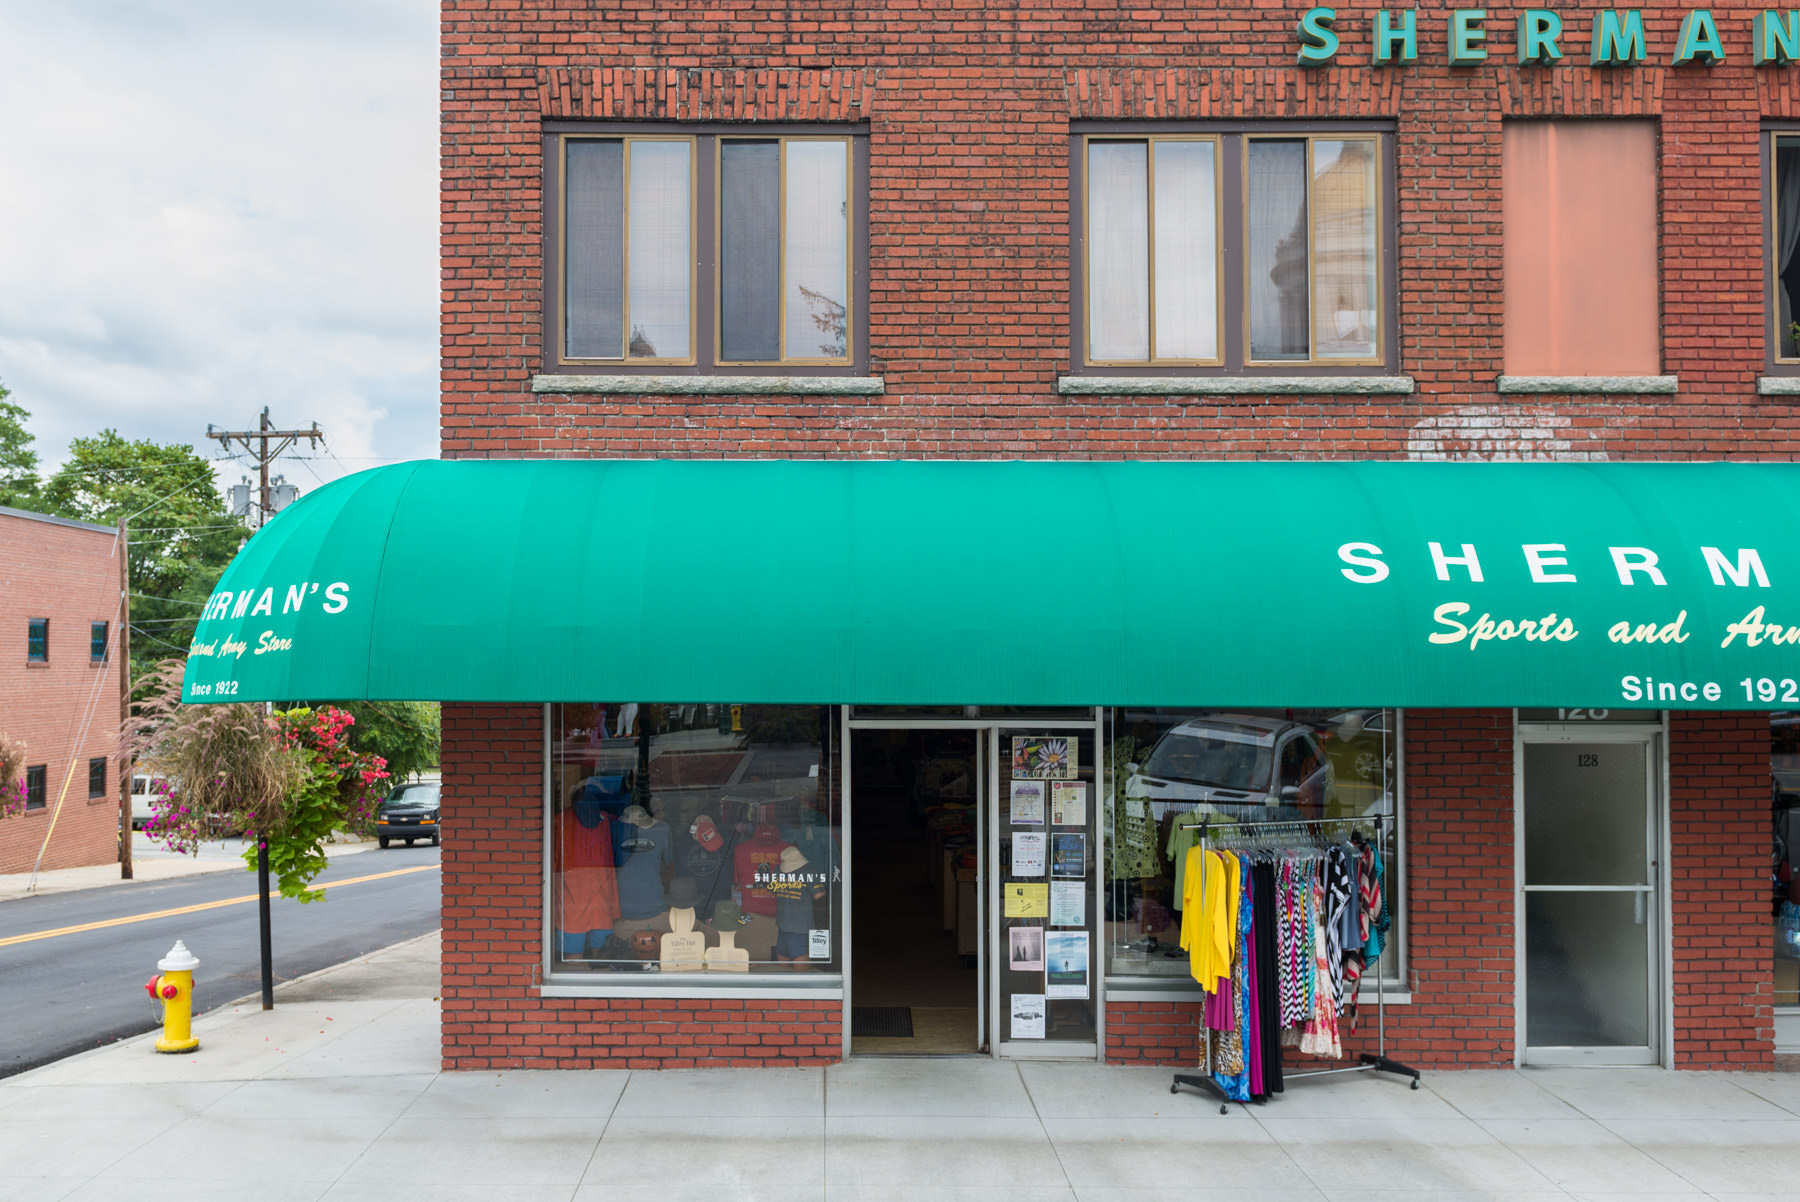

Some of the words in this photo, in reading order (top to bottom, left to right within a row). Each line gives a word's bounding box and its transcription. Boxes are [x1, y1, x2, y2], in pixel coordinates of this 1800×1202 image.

[1298, 7, 1800, 66] SHERMAN
[1337, 541, 1772, 588] SHERM
[1428, 601, 1579, 651] Sports
[1608, 609, 1690, 645] and
[254, 630, 292, 655] Store
[190, 683, 211, 696] Since
[215, 681, 238, 695] 1922
[1621, 676, 1722, 702] Since
[1740, 678, 1800, 702] 192
[1578, 754, 1598, 767] 128
[754, 873, 826, 883] SHERMAN'S
[766, 880, 807, 892] Sports
[811, 937, 826, 945] Tilley
